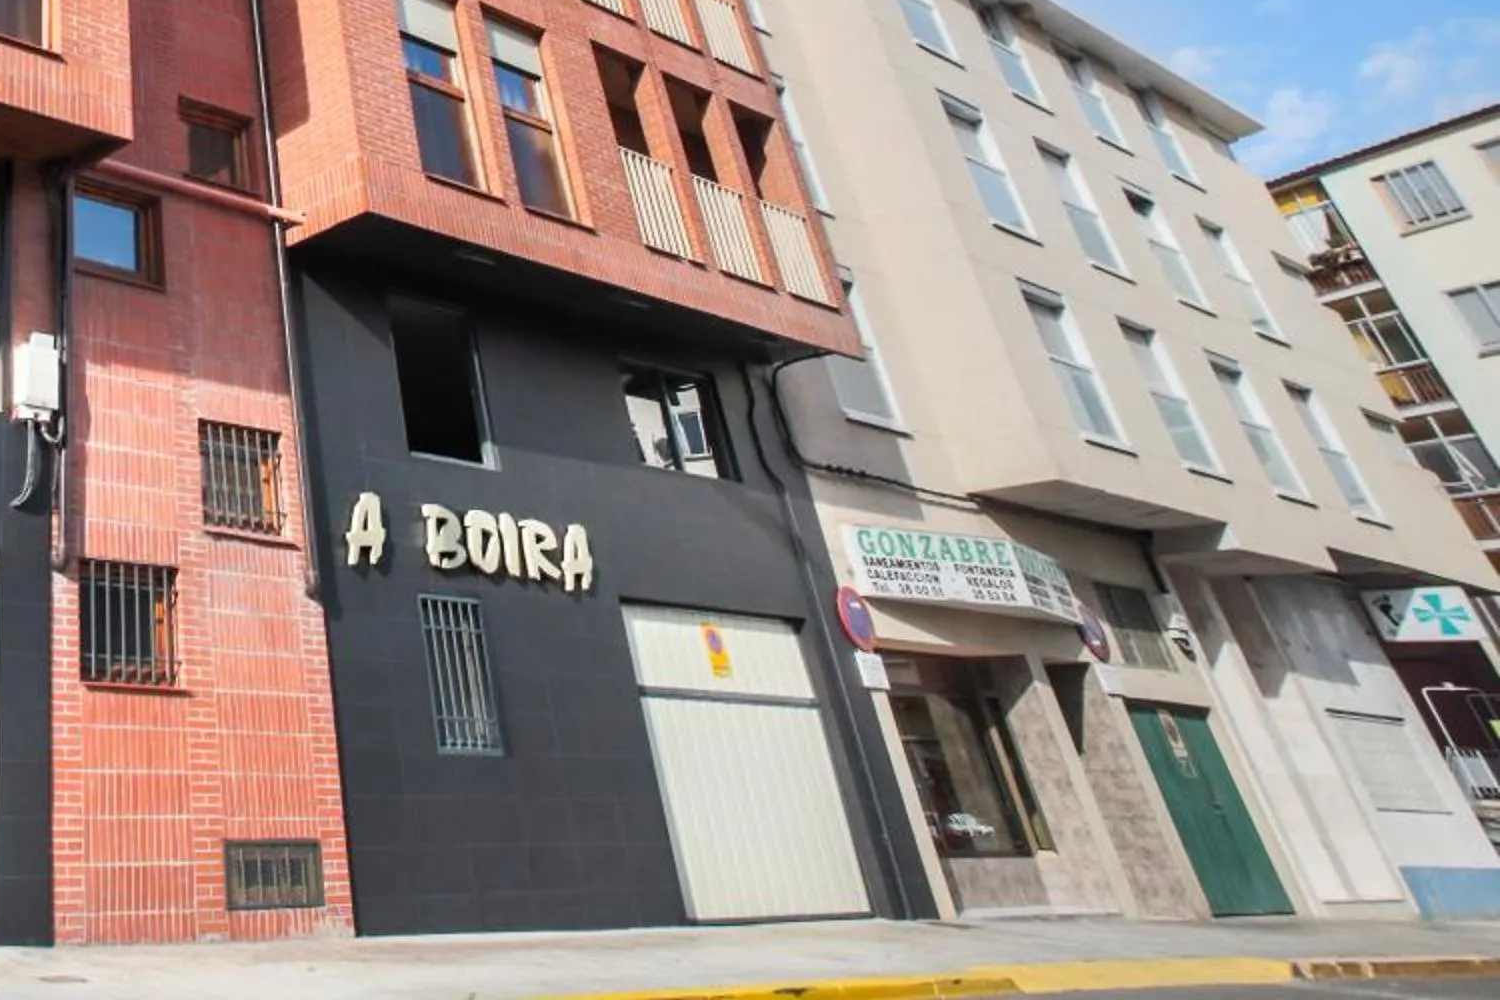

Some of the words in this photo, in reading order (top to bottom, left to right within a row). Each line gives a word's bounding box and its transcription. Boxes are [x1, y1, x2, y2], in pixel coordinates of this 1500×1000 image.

[345, 491, 386, 566] A
[420, 503, 593, 592] BOIRA
[857, 528, 1013, 567] GONZABRE
[862, 554, 941, 572] SANEAMIENTOS
[867, 568, 941, 584] CALEFACCION
[965, 575, 1015, 590] REGALOS
